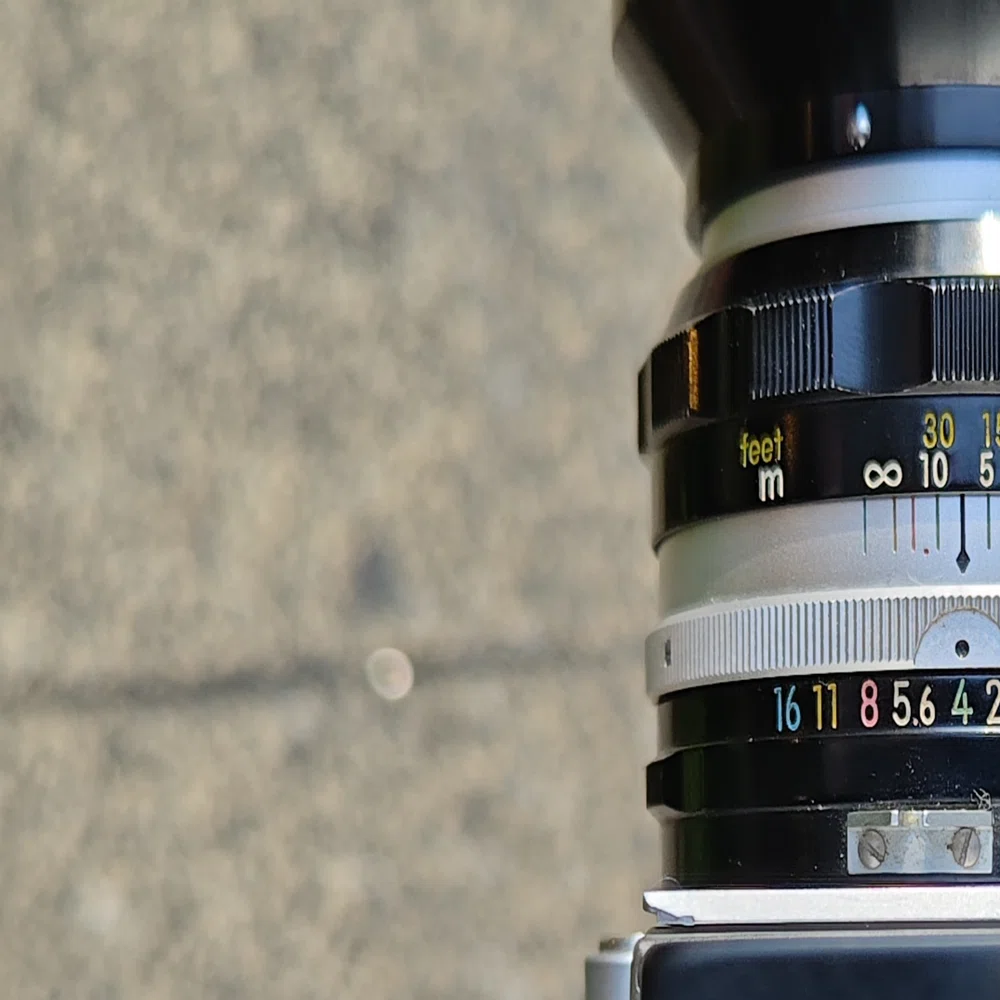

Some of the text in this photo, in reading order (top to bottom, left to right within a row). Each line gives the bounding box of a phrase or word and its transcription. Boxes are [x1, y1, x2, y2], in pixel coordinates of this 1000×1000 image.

[740, 430, 784, 469] feet
[923, 412, 955, 449] 30
[757, 466, 784, 502] m
[919, 450, 949, 488] 10
[979, 450, 995, 488] 5
[773, 684, 801, 732] 16
[812, 682, 838, 731] 11
[860, 679, 878, 729] 8
[892, 680, 936, 727] 5.6
[950, 678, 974, 725] 4
